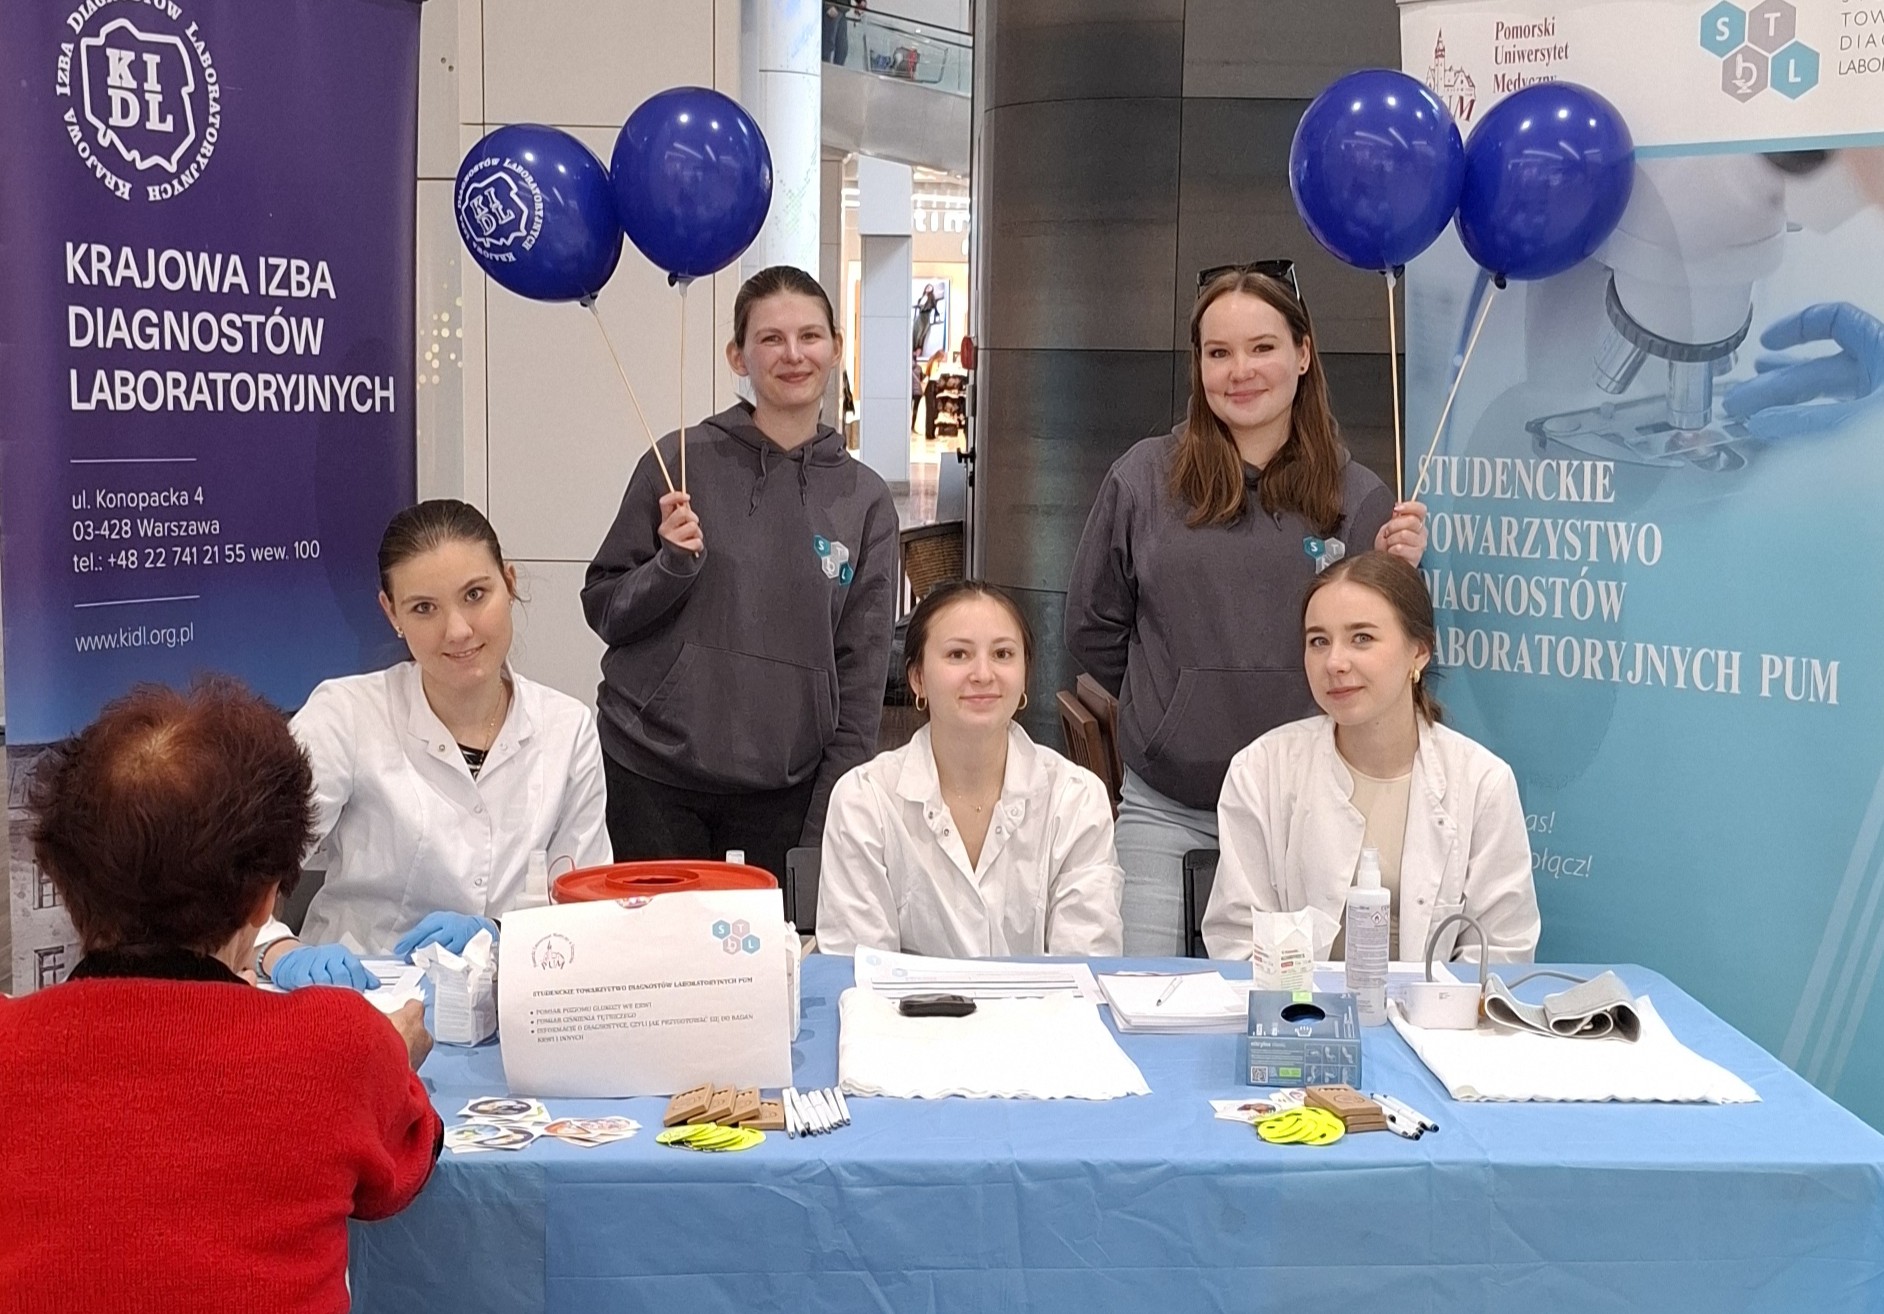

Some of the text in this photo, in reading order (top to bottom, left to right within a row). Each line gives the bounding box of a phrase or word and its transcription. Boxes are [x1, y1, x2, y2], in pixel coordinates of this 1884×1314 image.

[1495, 16, 1555, 41] Pomorski
[1840, 32, 1884, 51] DIA
[56, 42, 74, 96] IZBA
[1494, 41, 1569, 67] Uniwersytet
[1838, 57, 1884, 75] LABO
[147, 21, 221, 201] LABORATORYJNYCH
[63, 107, 132, 201] KRAJOWA
[66, 242, 337, 300] KRAJOWA IZBA
[68, 305, 324, 355] DIAGNOSTÓW
[70, 368, 396, 413] LABORATORYJNYCH
[1417, 455, 1615, 503] STUDENCKIE
[72, 486, 204, 511] ul. Konopacka 4
[72, 517, 220, 541] 03-428 Warszawa
[1425, 512, 1663, 566] OWARZYSTWO
[73, 540, 320, 573] tel.: +48 22 741 21 55 wew. 100
[75, 621, 194, 652] www.kidl.org.pl
[1431, 625, 1840, 705] ABORATORYJNYCH PUM
[1525, 811, 1556, 834] as!
[1531, 847, 1593, 879] ołącz!
